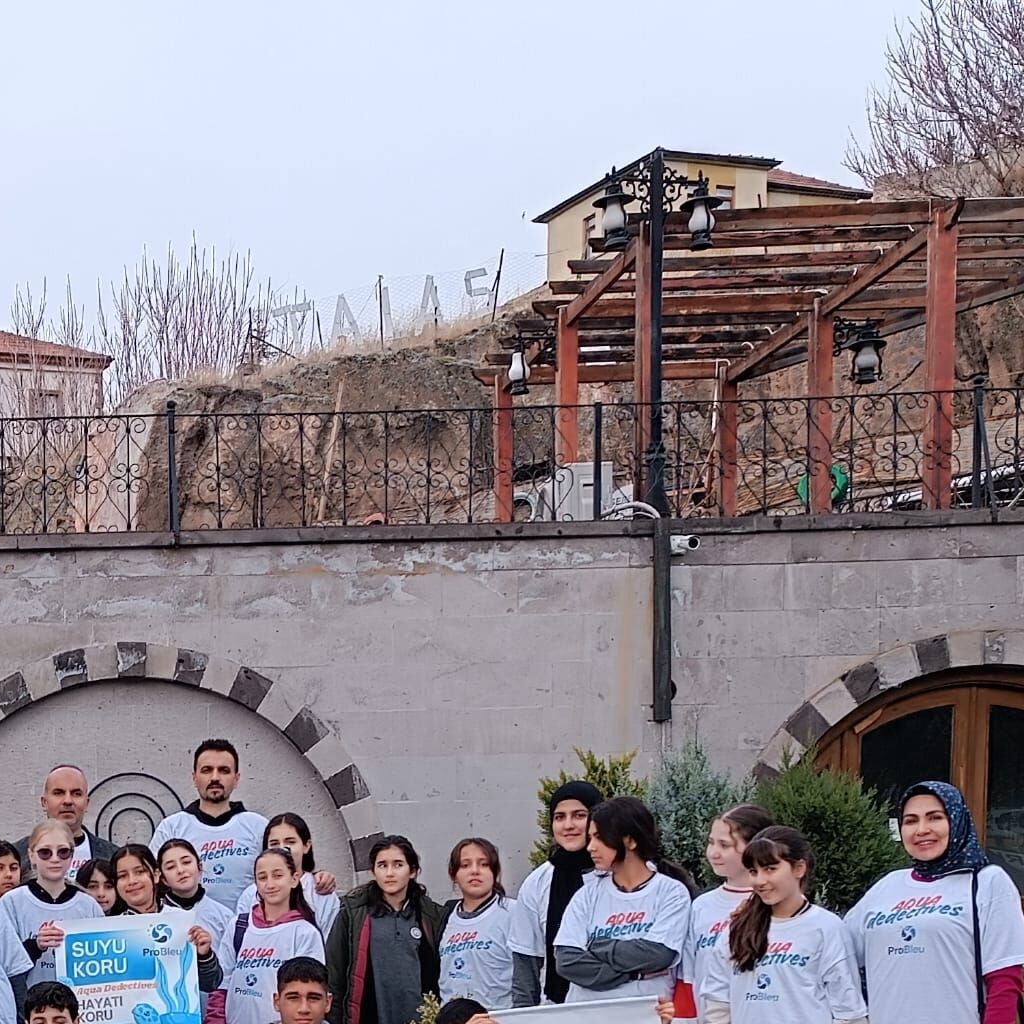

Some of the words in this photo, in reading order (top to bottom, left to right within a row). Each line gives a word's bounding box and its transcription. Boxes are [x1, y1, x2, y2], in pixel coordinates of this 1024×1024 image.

[201, 839, 234, 852] AQUA
[200, 847, 249, 862] dectives
[891, 895, 942, 912] AQUA
[605, 912, 646, 926] AQUA
[866, 904, 964, 930] dedectives
[447, 931, 478, 945] AQUA
[71, 937, 127, 958] SUYU
[142, 946, 183, 957] ProBleu
[240, 947, 275, 959] AQUA
[888, 945, 925, 955] ProBleu
[73, 957, 128, 978] KORU
[77, 985, 103, 996] Aqua
[104, 981, 160, 993] Dedectives
[77, 996, 123, 1011] HAYATI
